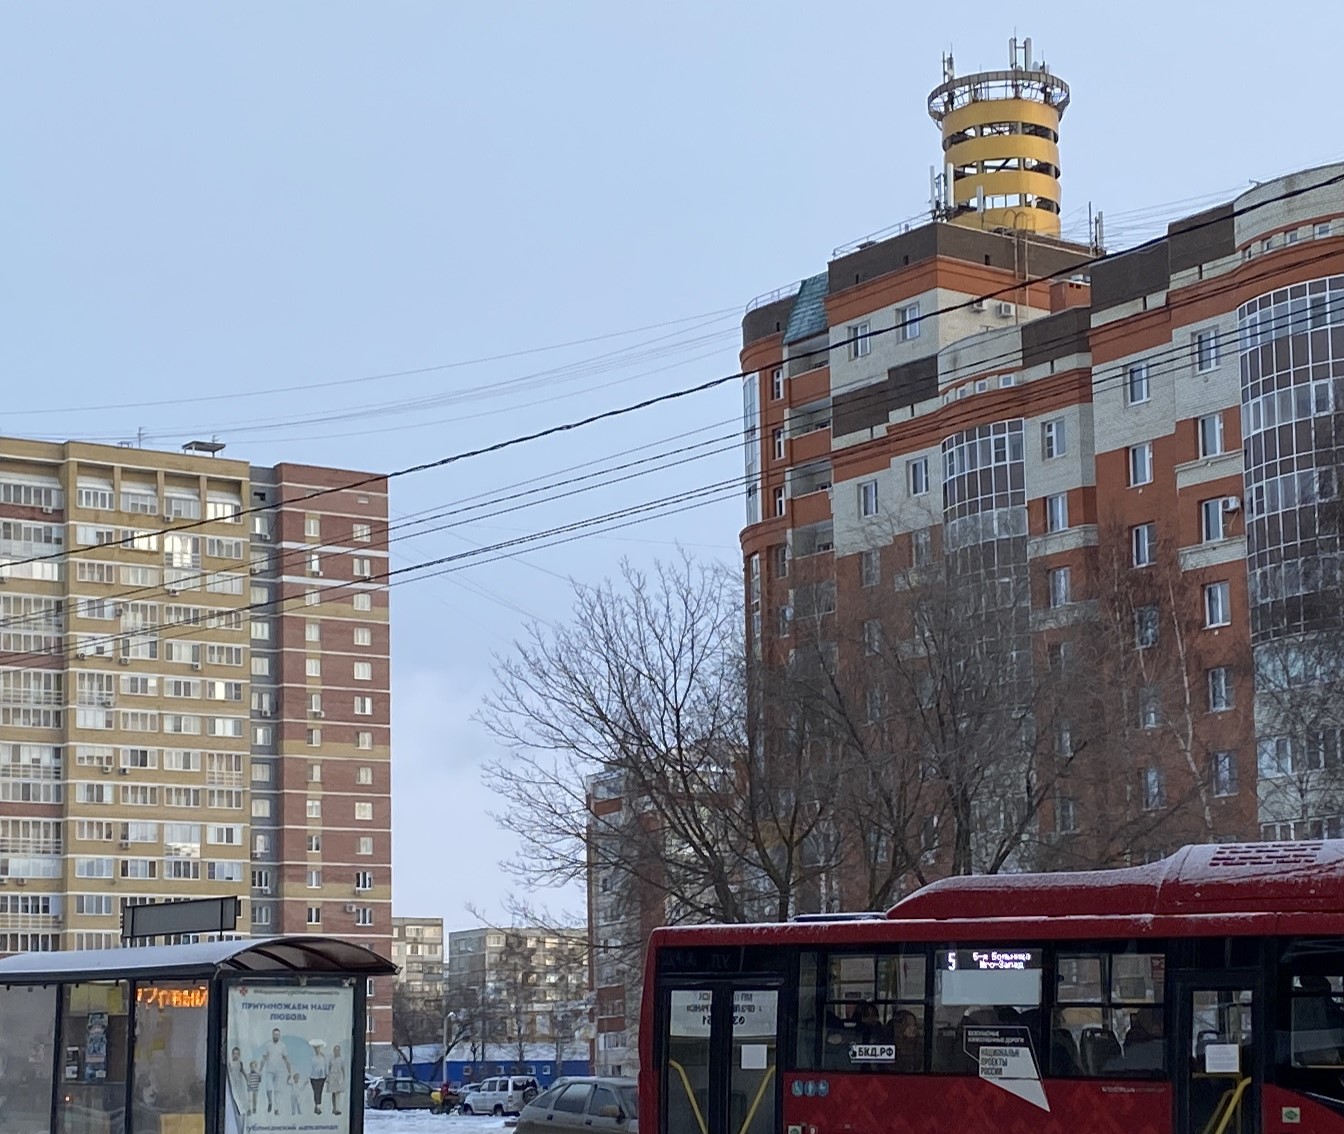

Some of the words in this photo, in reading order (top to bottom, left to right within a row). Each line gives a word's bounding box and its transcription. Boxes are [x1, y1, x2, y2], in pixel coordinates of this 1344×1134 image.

[948, 952, 956, 970] 5
[242, 1002, 308, 1010] ПРИУМНОЖАЕМ
[311, 1003, 335, 1011] НАШУ
[858, 1047, 894, 1058] БКД.РФ
